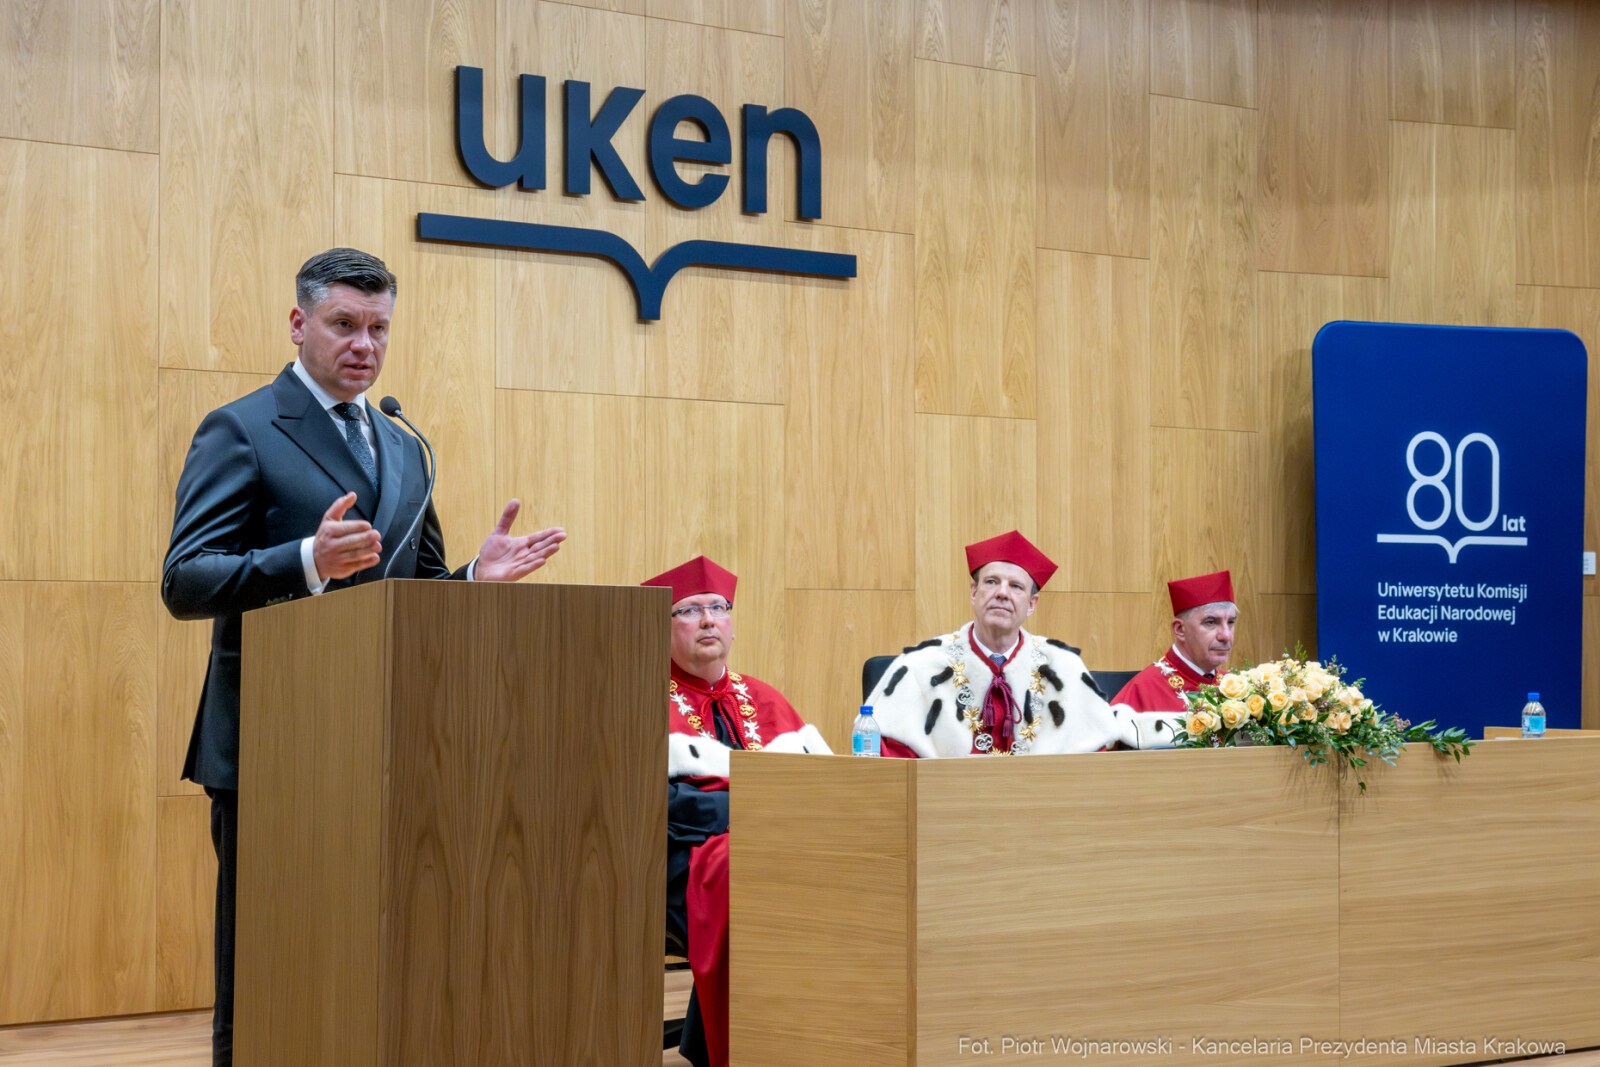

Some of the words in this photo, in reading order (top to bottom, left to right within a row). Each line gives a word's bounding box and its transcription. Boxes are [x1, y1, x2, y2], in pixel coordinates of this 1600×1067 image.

[455, 65, 822, 220] uken
[1406, 431, 1500, 531] 80
[1502, 514, 1526, 532] lat
[1377, 582, 1474, 602] Uniwersytetu
[1477, 583, 1528, 603] Komisji
[1377, 605, 1438, 624] Edukacji
[1441, 606, 1516, 625] Narodowej
[1378, 631, 1390, 643] w
[1393, 628, 1458, 643] Krakowie
